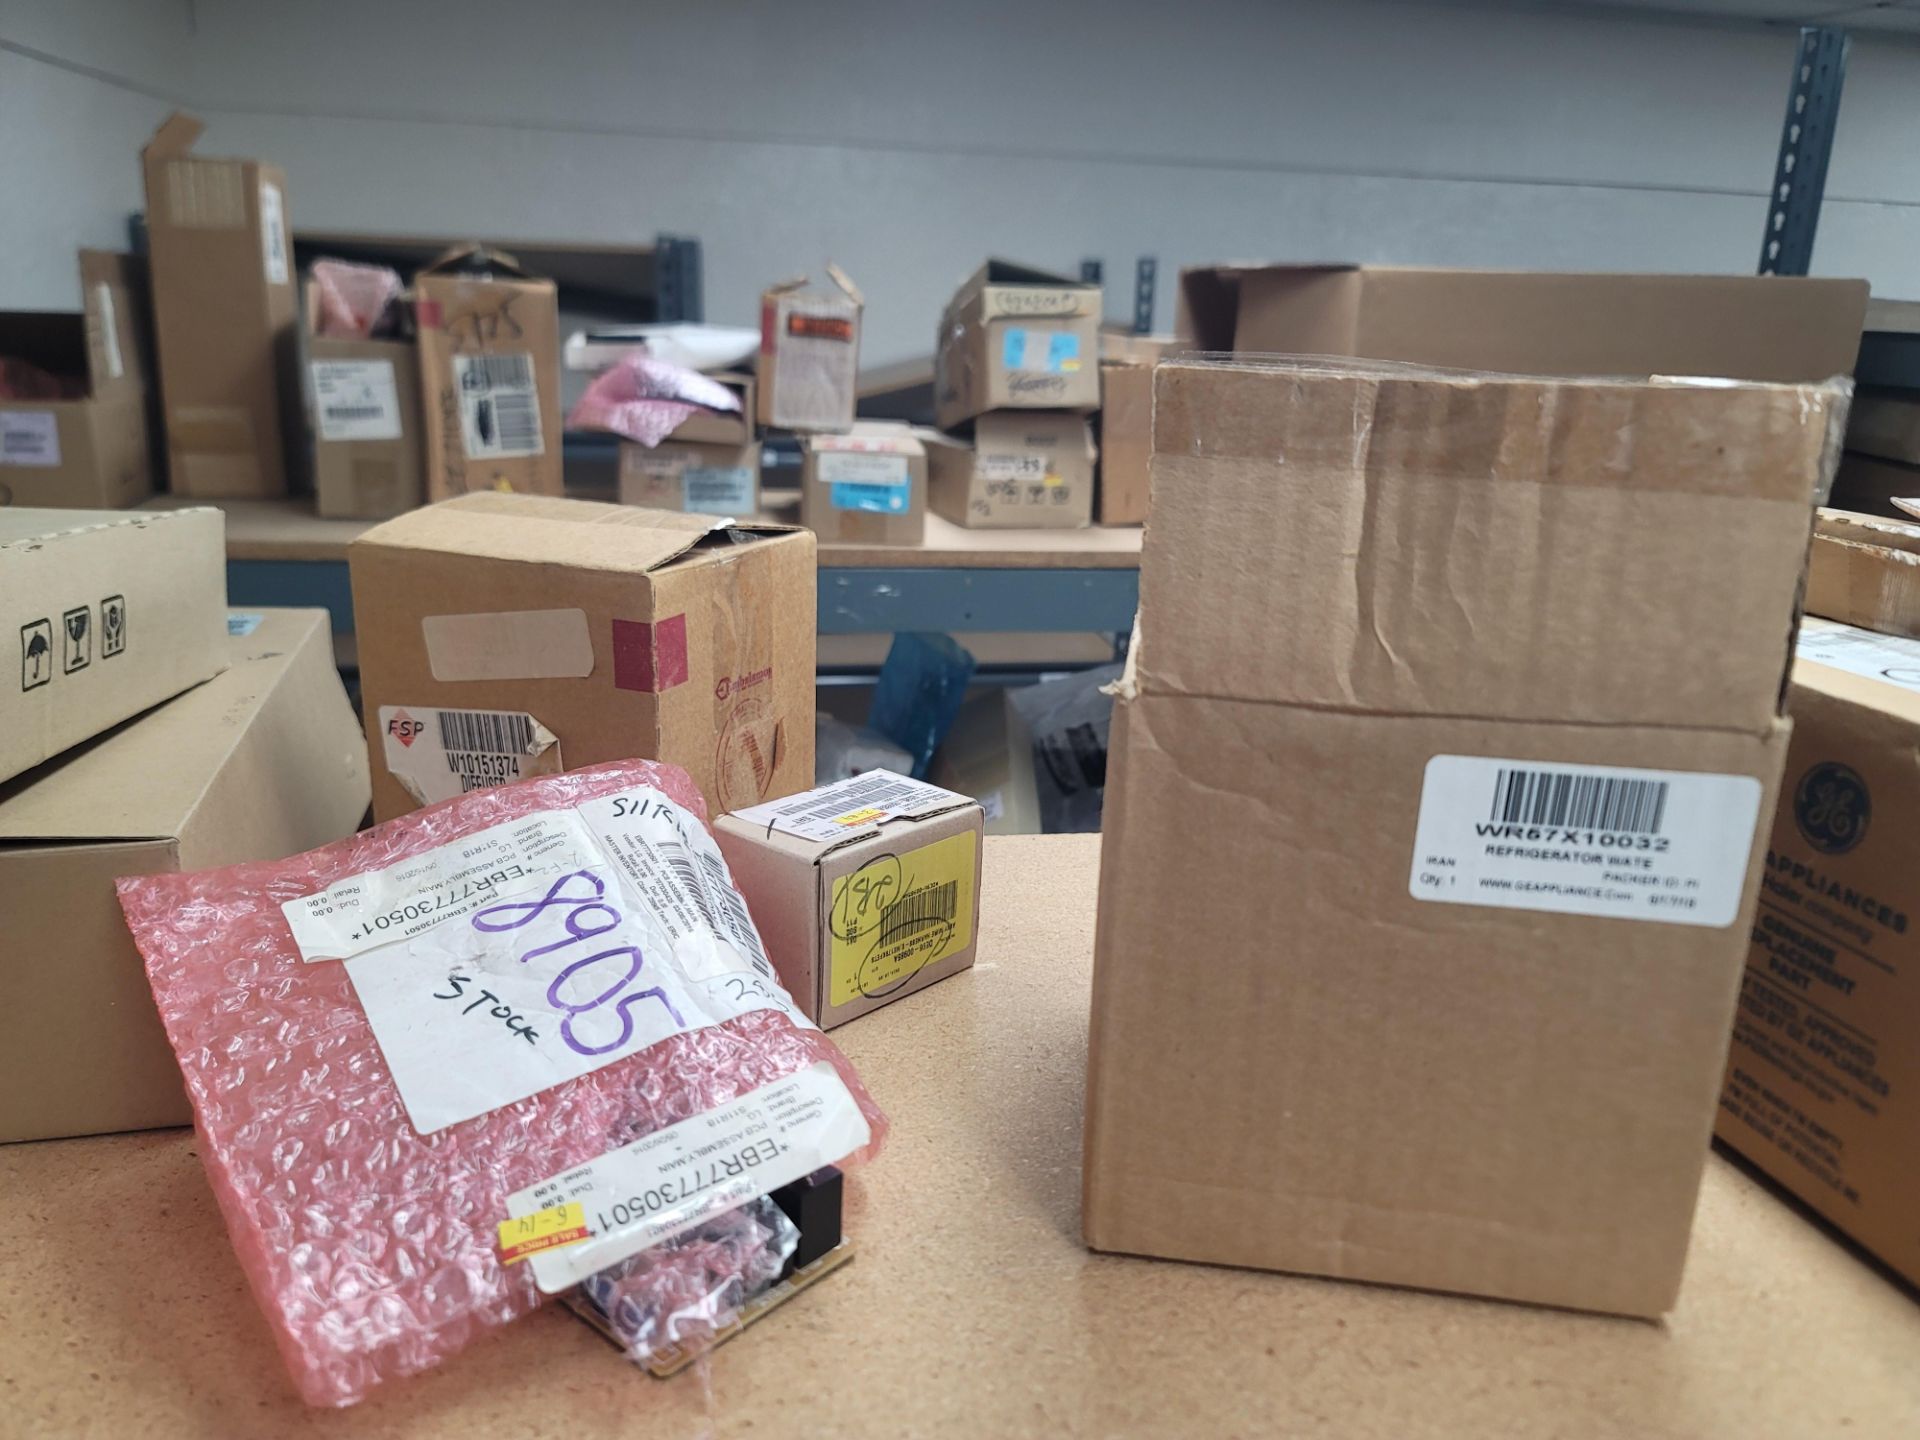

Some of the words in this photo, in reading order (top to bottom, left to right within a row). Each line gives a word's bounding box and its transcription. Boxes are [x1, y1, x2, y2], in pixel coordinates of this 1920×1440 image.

[388, 719, 425, 736] FSP
[446, 752, 520, 777] W10151374
[1485, 844, 1604, 866] REFRIGERATOR
[1766, 850, 1910, 935] APPLIANCES
[433, 974, 540, 1047] STOCK
